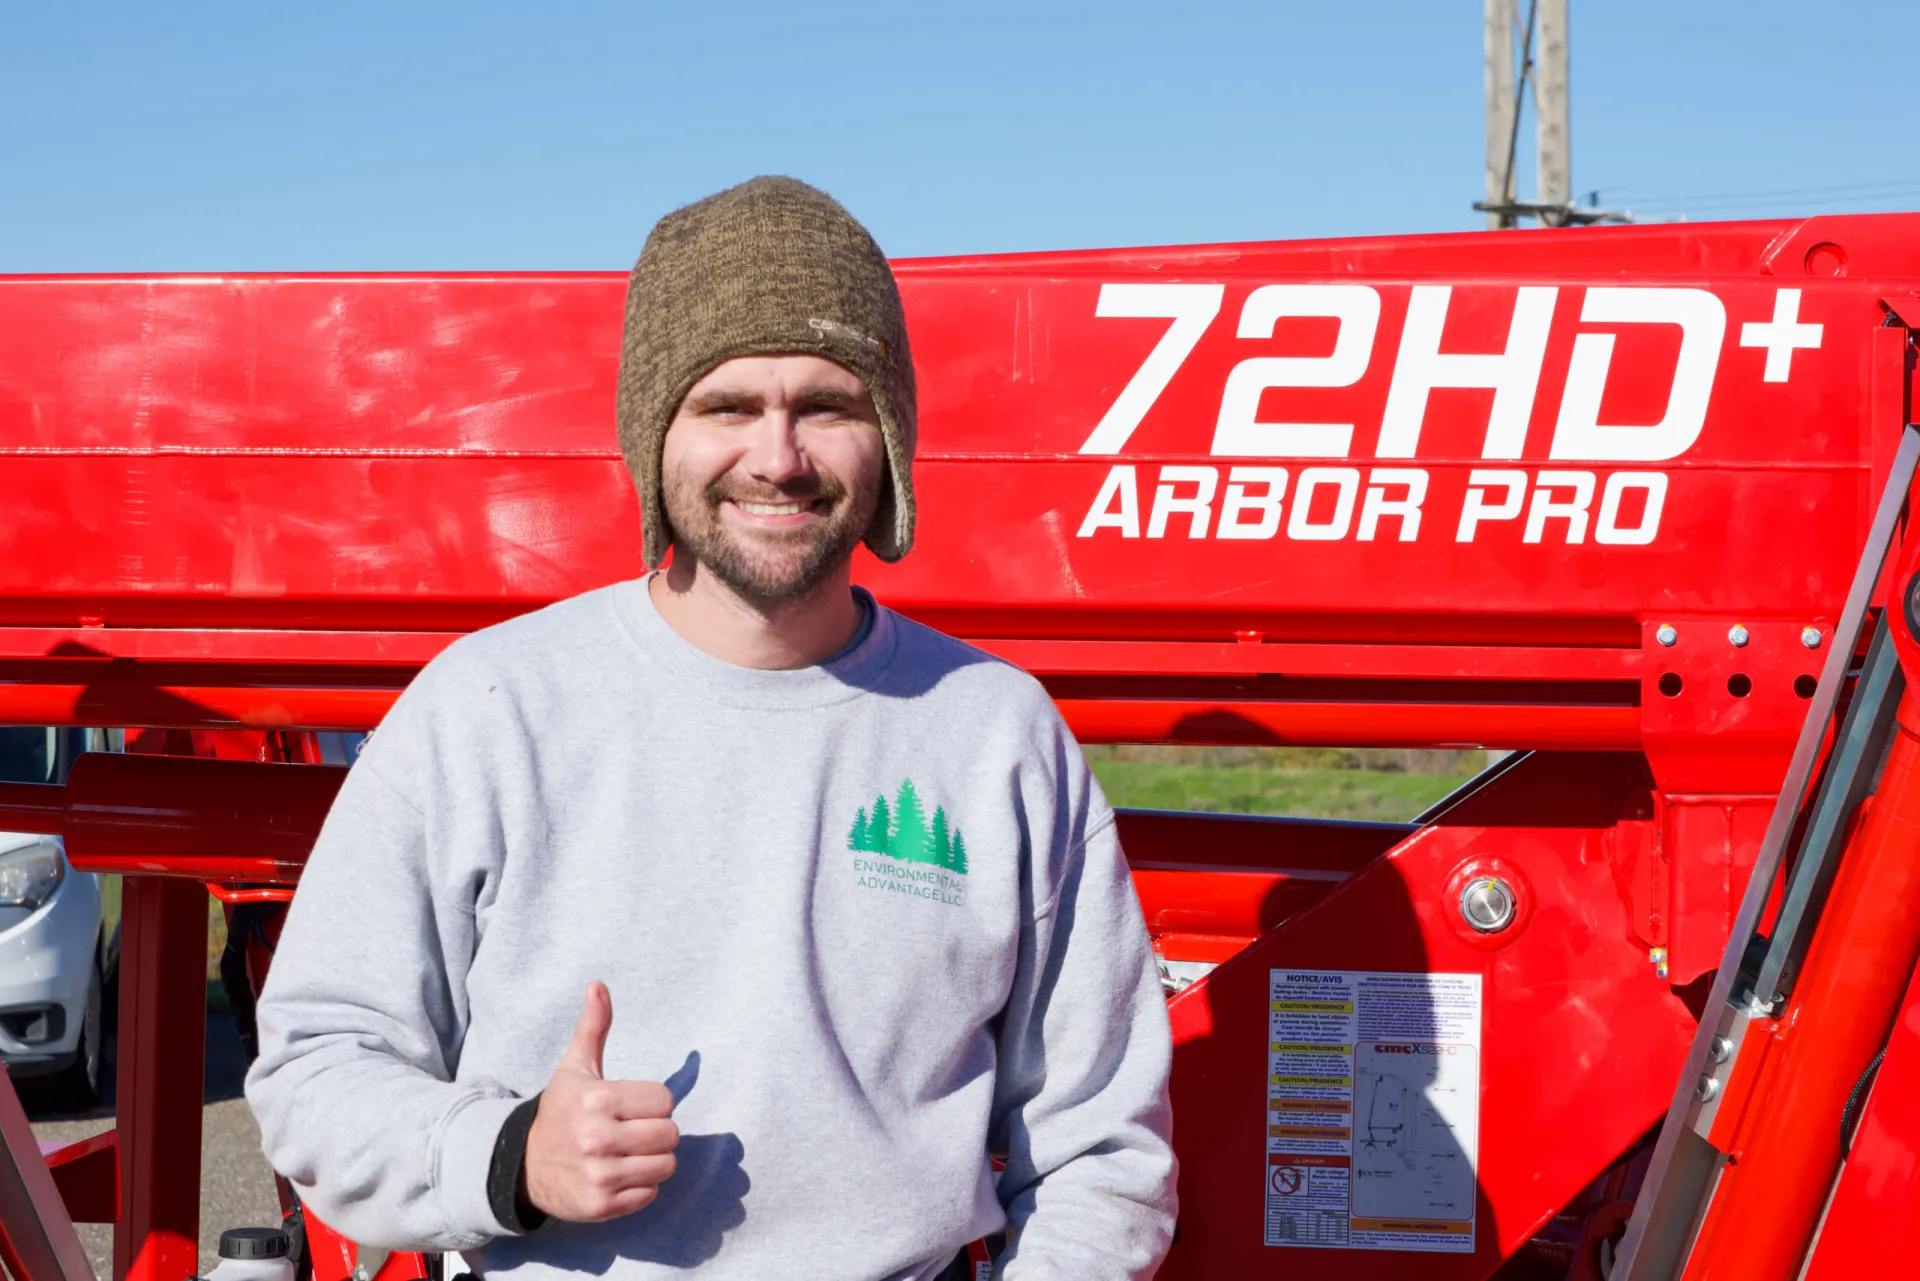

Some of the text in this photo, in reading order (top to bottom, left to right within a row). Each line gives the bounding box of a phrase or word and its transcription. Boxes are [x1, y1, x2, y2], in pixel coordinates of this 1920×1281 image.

[1076, 466, 1669, 544] ARBOR PRO
[853, 859, 963, 893] ENVIRONMENTAL
[857, 876, 963, 907] ADVANTAGE LLC
[1286, 974, 1343, 984] NOTICE/AVIS
[1279, 1044, 1344, 1052] CAUTION/PRUDENCE
